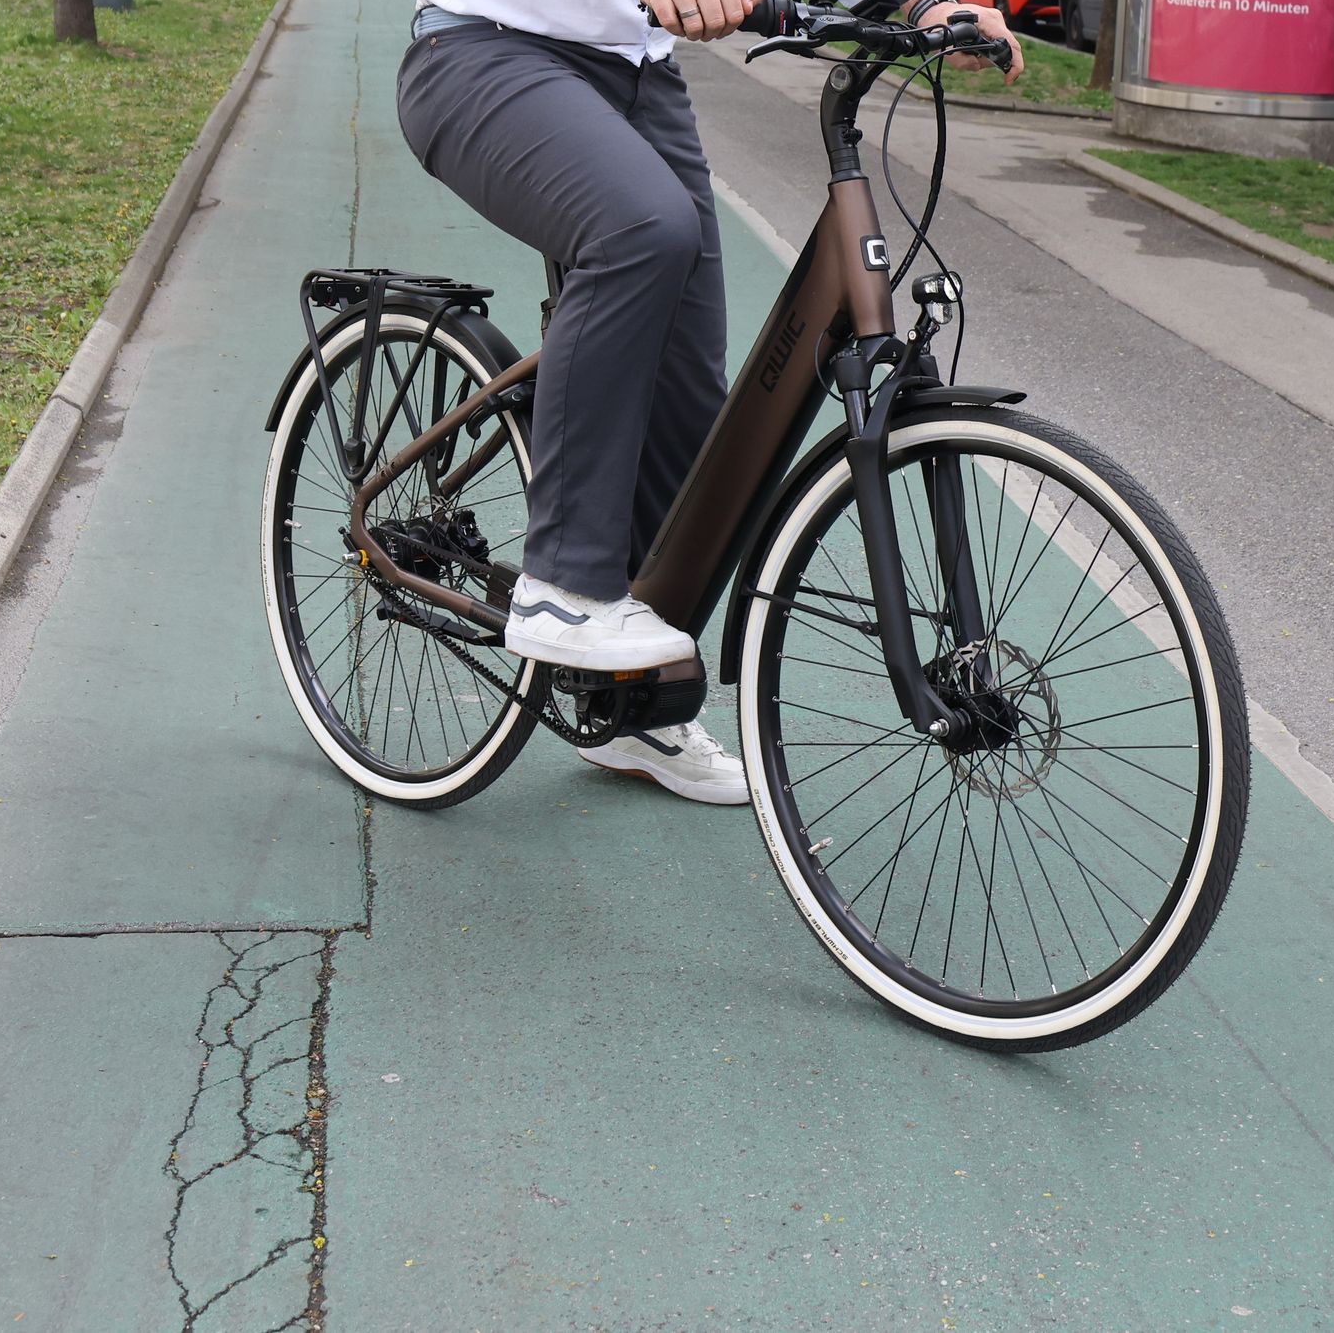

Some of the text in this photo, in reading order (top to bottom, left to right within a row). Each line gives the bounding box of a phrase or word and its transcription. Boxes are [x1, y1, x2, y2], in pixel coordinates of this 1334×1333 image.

[1253, 0, 1309, 15] Minuten
[759, 311, 807, 394] QWIC
[761, 812, 849, 961] SCHWALBE ROAD CRUISER
